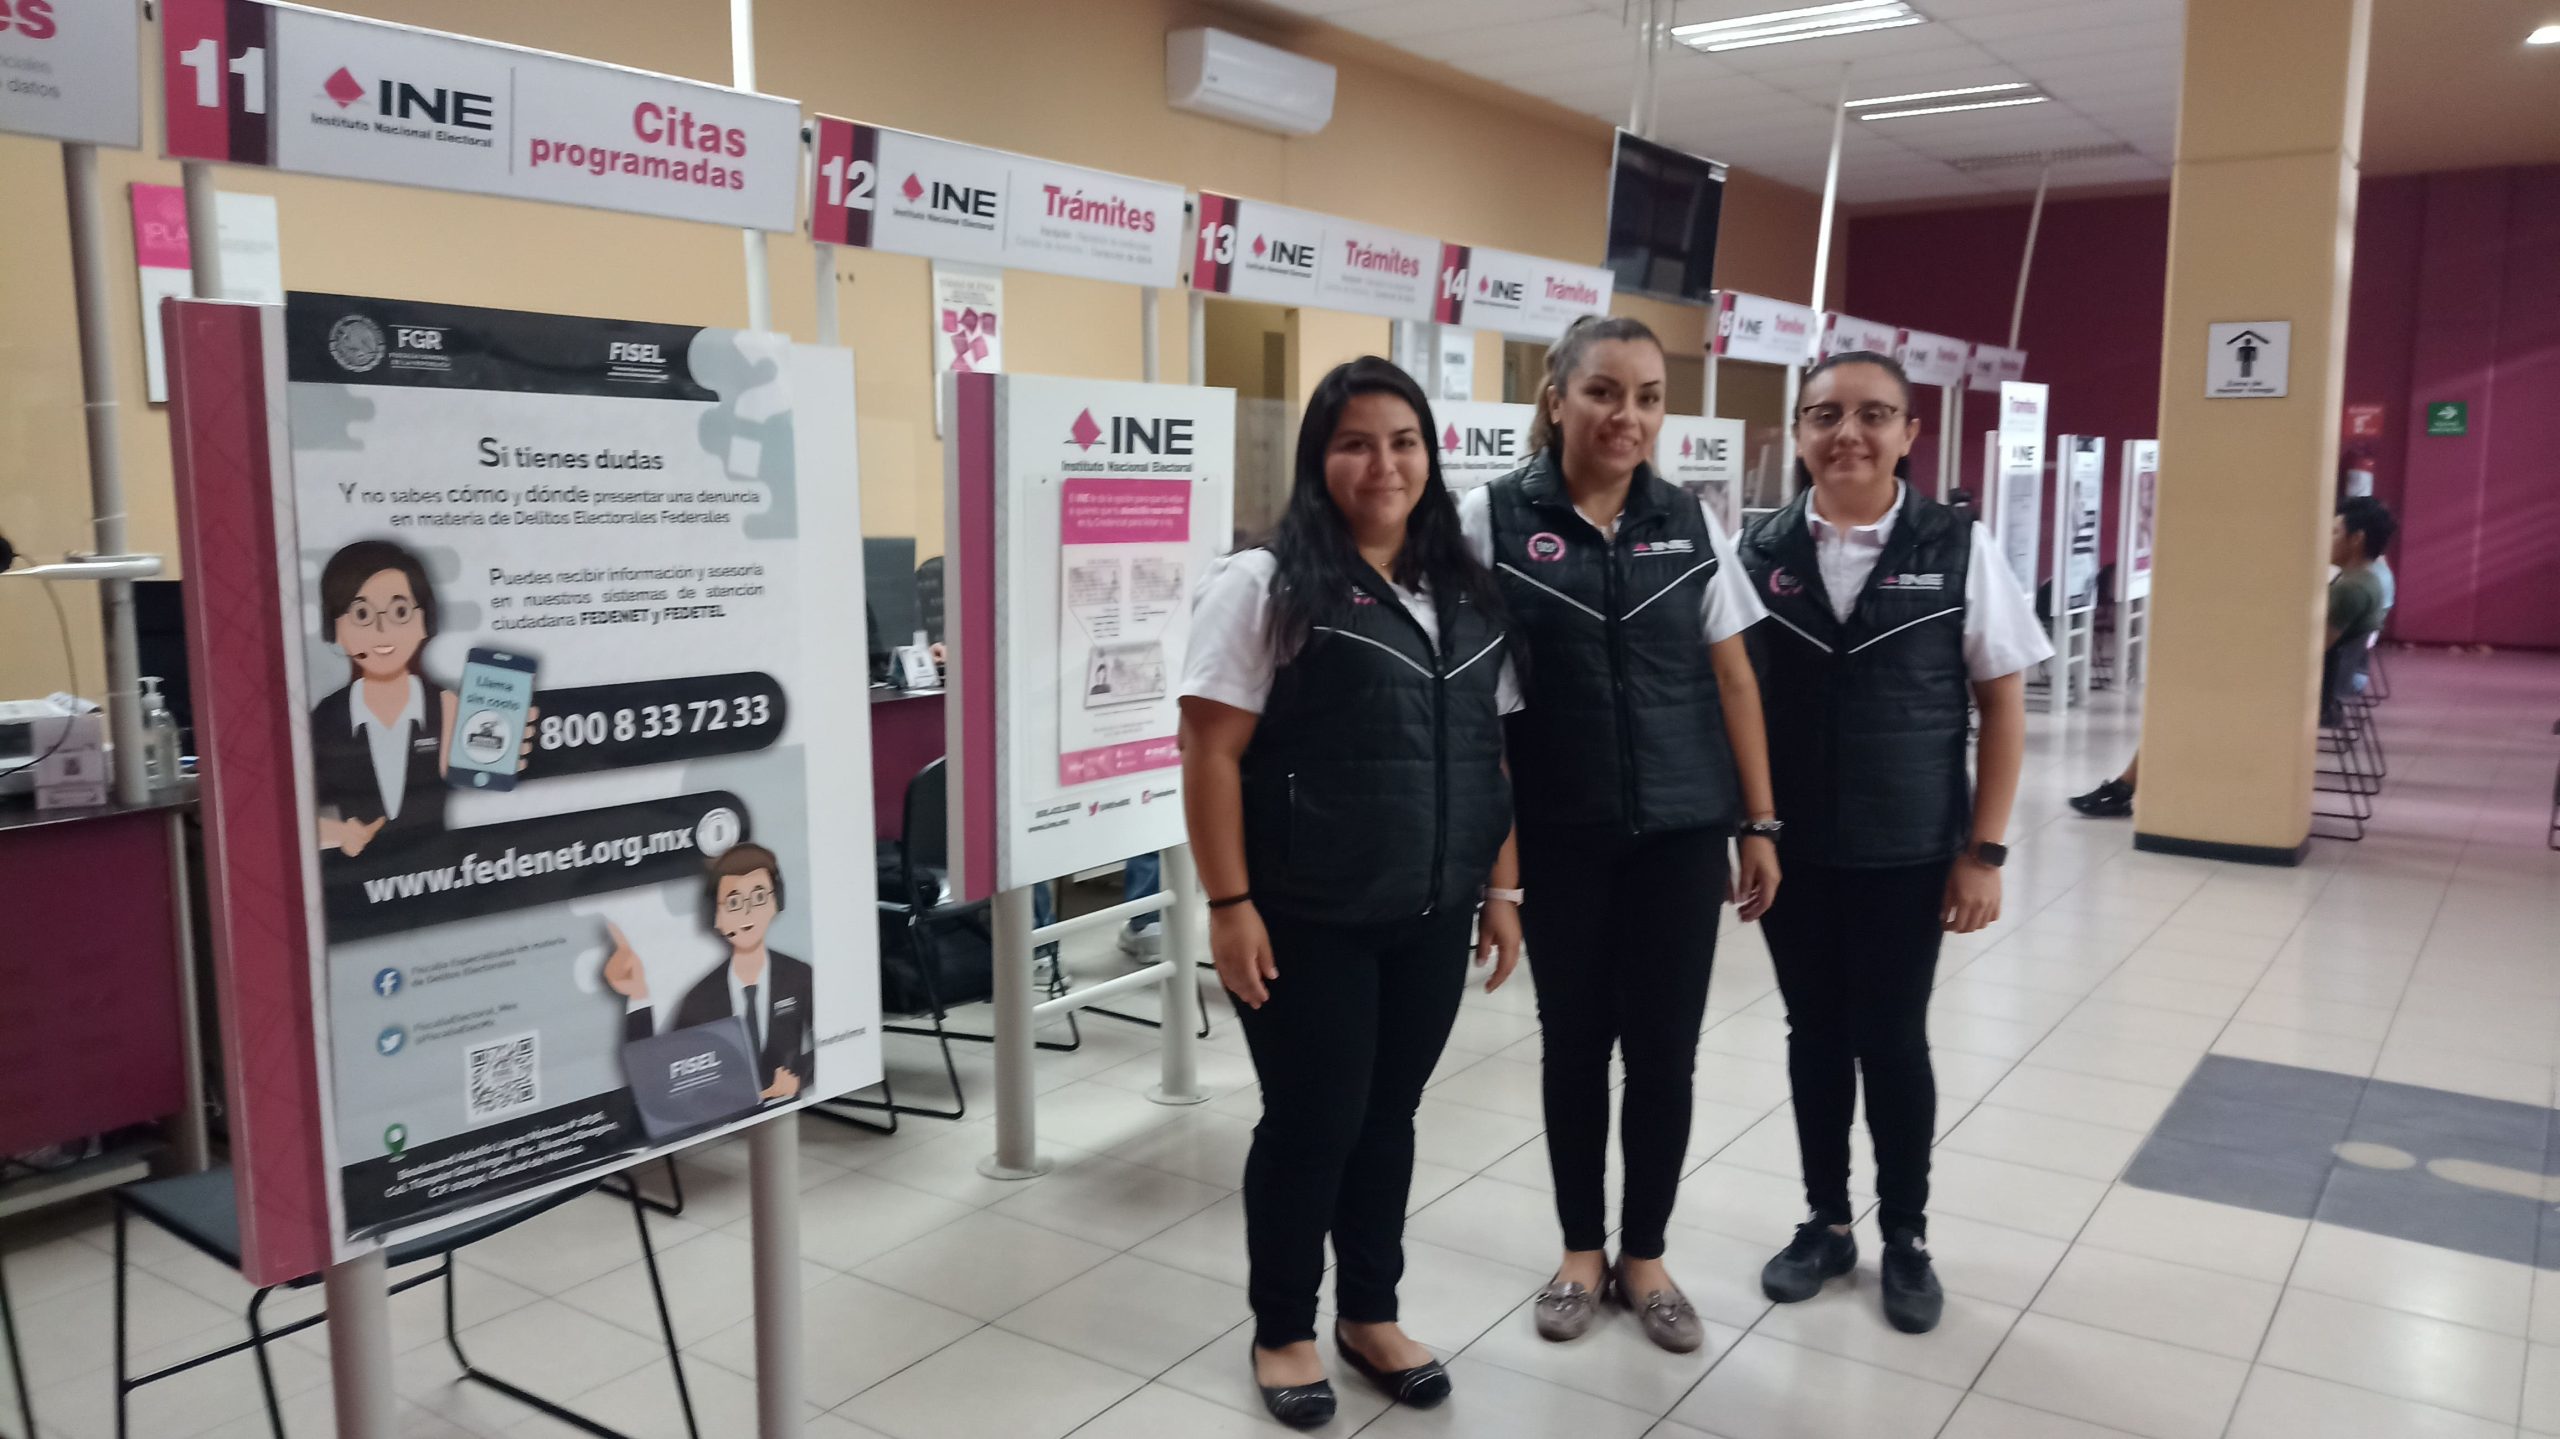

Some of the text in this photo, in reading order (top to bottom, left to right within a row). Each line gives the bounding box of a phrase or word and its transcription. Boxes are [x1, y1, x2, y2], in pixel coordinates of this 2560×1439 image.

[180, 38, 266, 114] 11
[379, 79, 493, 131] INE
[311, 112, 493, 149] Instituto Nacional Electoral
[634, 101, 747, 157] Citas
[530, 138, 745, 190] programadas
[821, 155, 875, 211] 12
[931, 181, 997, 218] INE
[1043, 183, 1156, 233] Trámites
[1200, 221, 1236, 266] 13
[1271, 239, 1315, 268] INE
[1345, 239, 1420, 278] Trámites
[1441, 266, 1467, 301] 14
[1491, 279, 1524, 302] INE
[1545, 275, 1598, 305] Trámites
[398, 328, 443, 350] FGR
[609, 342, 666, 363] FISEL
[1111, 416, 1194, 455] INE
[1465, 428, 1514, 456] INE
[1695, 438, 1727, 461] INE
[478, 437, 664, 471] Si tienes dudas
[1062, 461, 1192, 472] Instituto Nacional Electoral
[338, 482, 760, 507] Y no sabes cómo y dónde presentar una denuncia
[390, 510, 730, 527] en materia de Delitos Electorales Federales
[489, 564, 764, 586] Puedes recibir información y asesoría
[491, 582, 765, 608] en nuestros sistemas de atención
[491, 604, 727, 631] ciudadana FEDENET y FEDETEL
[540, 693, 770, 751] 800 8 33 72 33
[363, 824, 694, 905] www.fedenet.org.mx
[668, 1051, 722, 1079] FISEL
